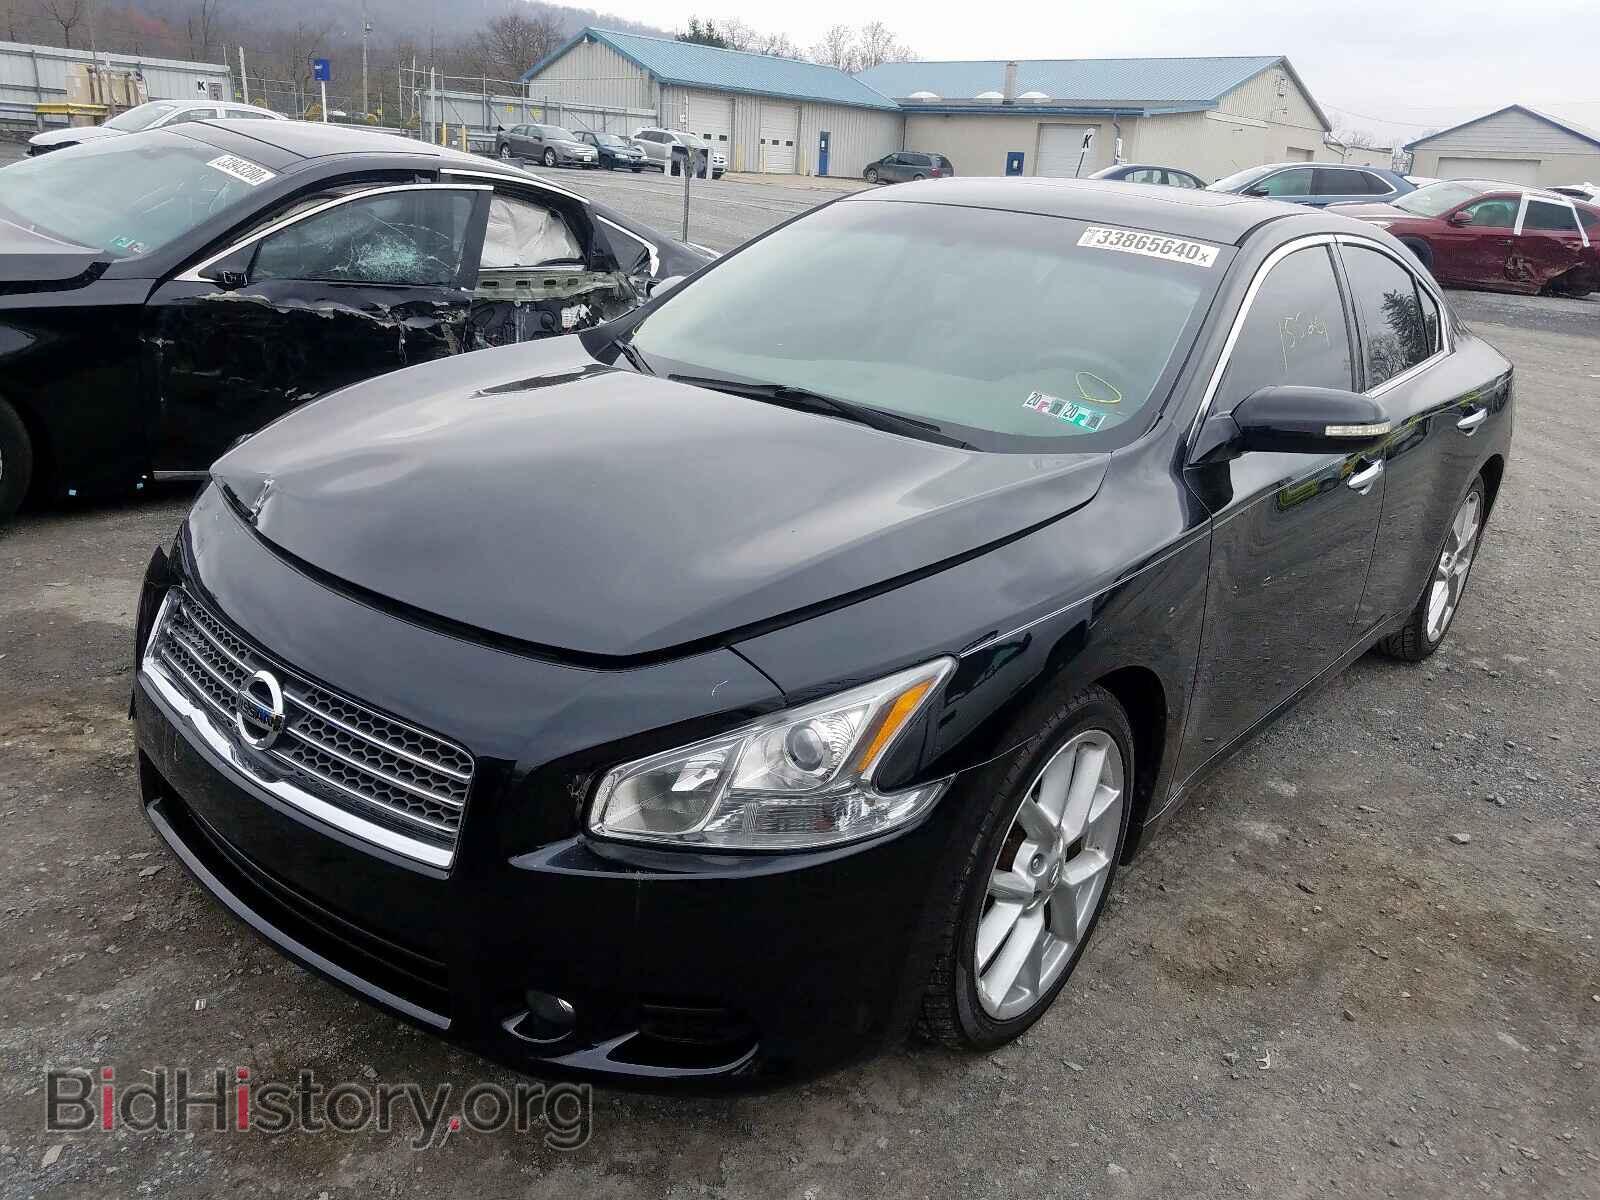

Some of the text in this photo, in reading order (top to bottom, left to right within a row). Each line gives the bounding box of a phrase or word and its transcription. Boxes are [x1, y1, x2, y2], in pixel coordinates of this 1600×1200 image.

[197, 81, 206, 91] K
[1082, 134, 1093, 149] K
[1096, 230, 1201, 260] 33865640
[1026, 392, 1042, 407] 20
